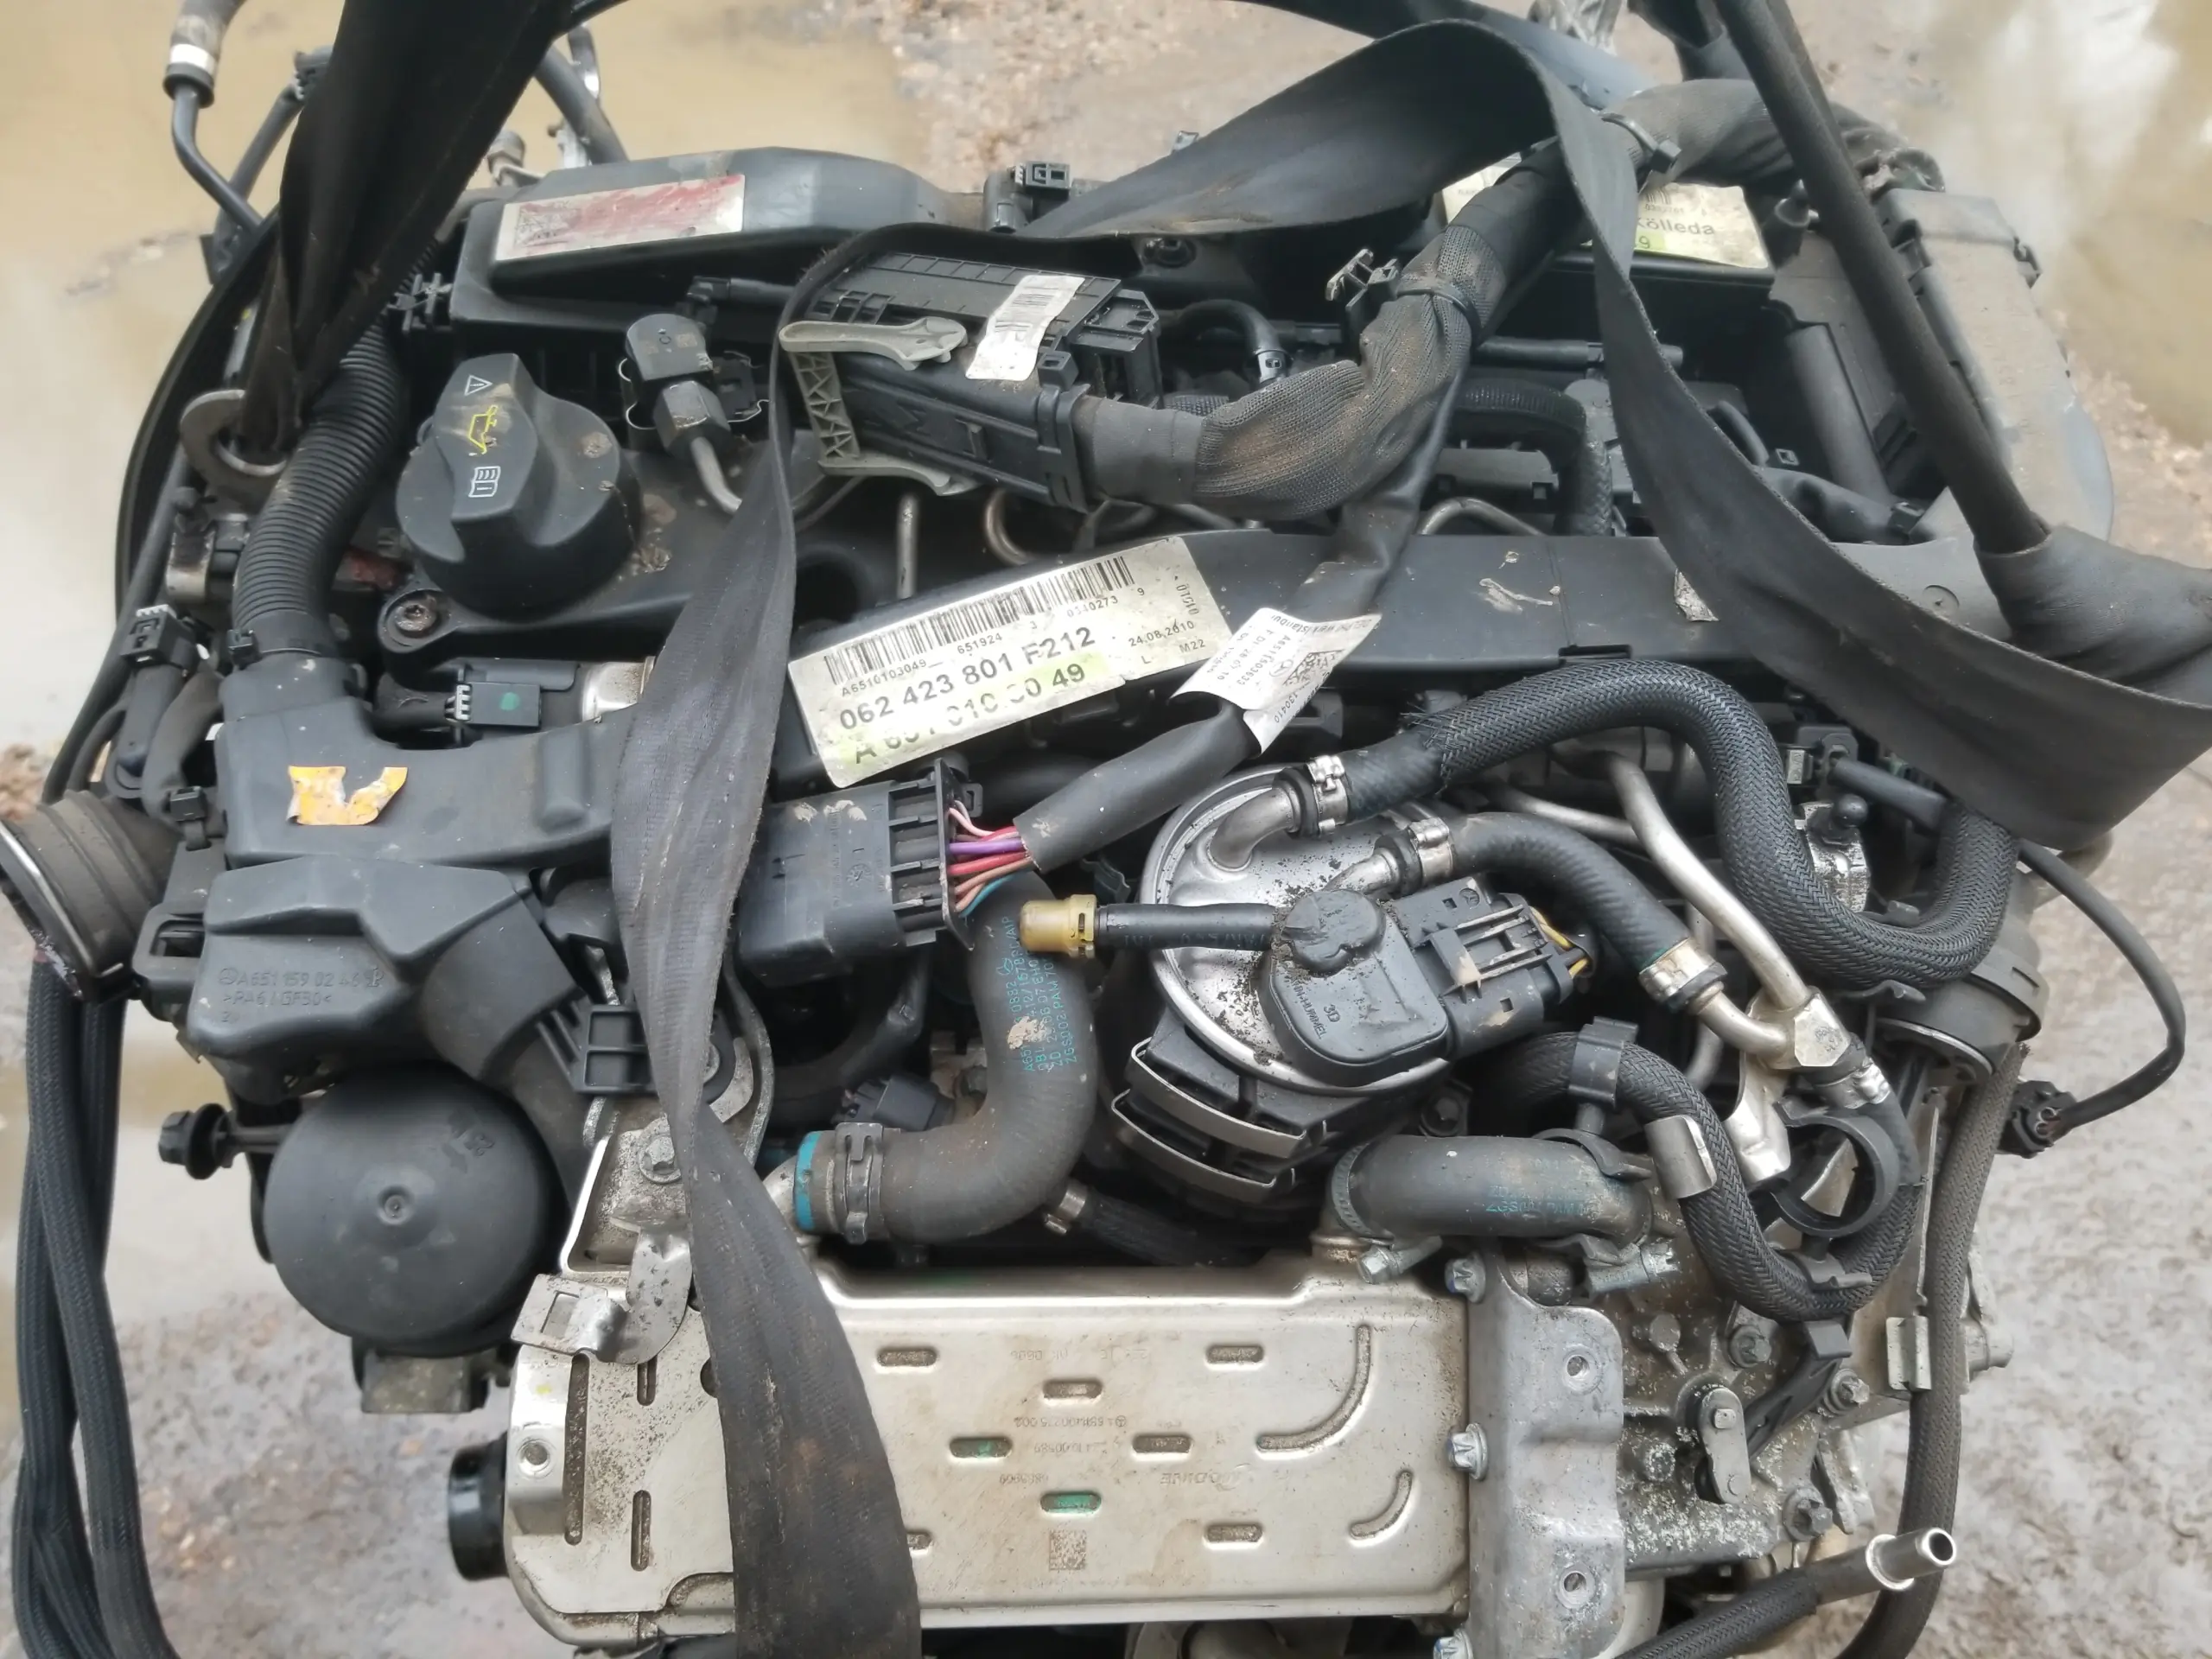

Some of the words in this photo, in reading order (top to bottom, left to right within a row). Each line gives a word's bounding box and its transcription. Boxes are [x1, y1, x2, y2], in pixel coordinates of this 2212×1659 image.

[956, 631, 1003, 655] 651924
[1136, 586, 1146, 597] 9
[1179, 638, 1205, 654] M22
[837, 694, 894, 732] 062
[899, 671, 956, 707] 423
[961, 652, 1014, 686] 801
[1020, 624, 1096, 665] F212
[1048, 660, 1087, 690] 49
[314, 970, 334, 988] 02
[1323, 1003, 1341, 1022] 3D
